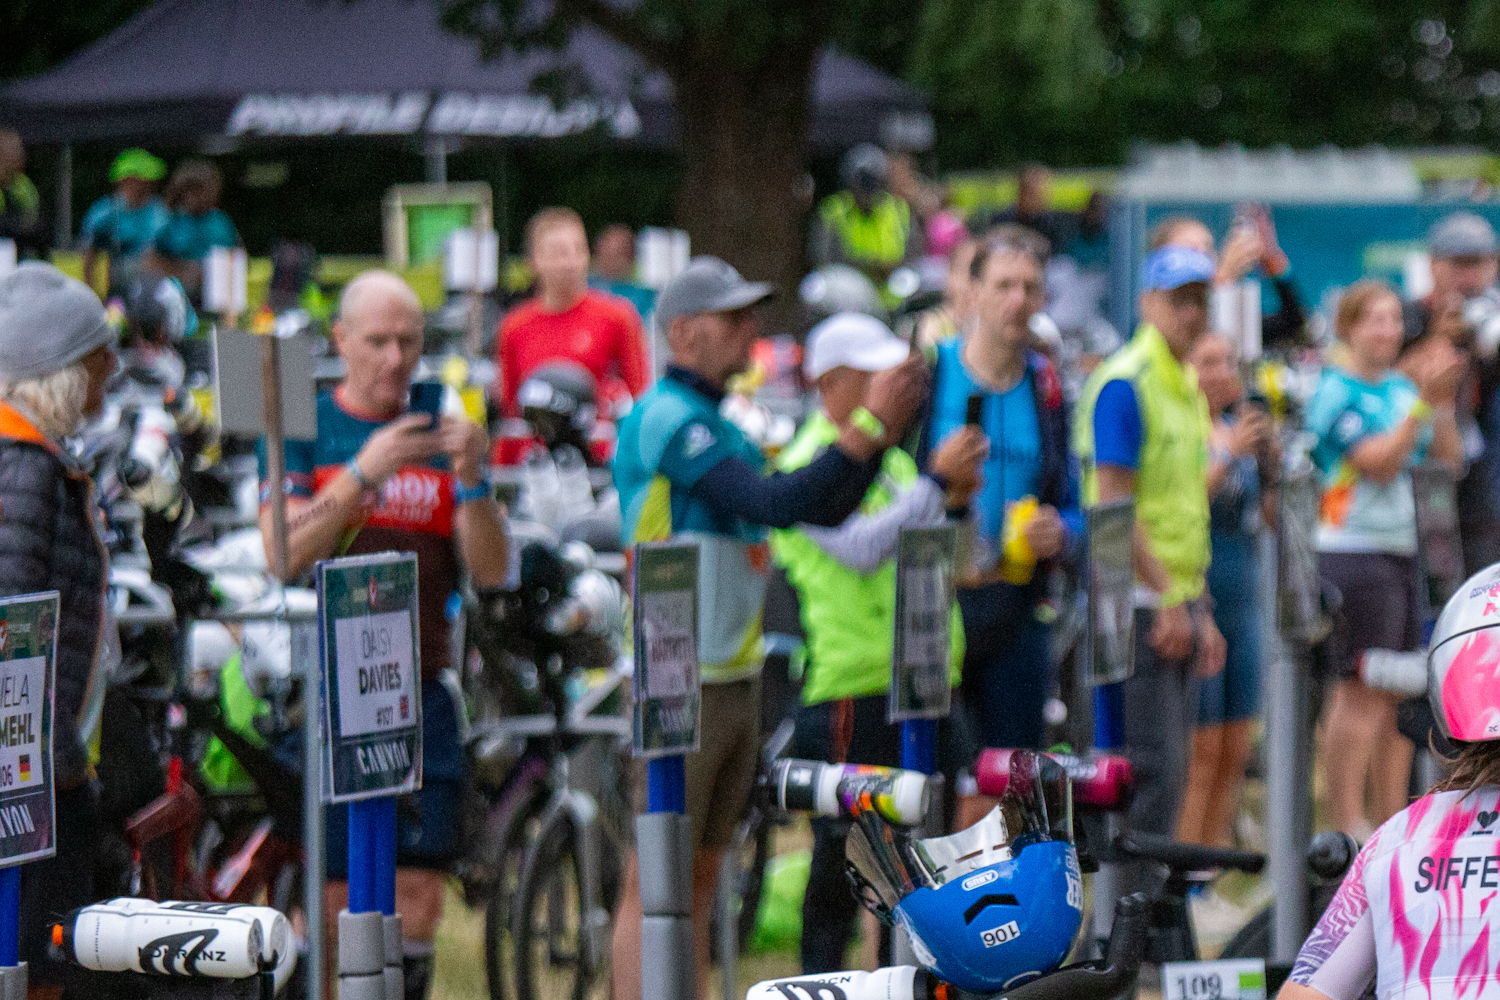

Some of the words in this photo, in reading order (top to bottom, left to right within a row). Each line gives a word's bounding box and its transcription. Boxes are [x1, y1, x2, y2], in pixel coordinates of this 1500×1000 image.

[359, 662, 402, 695] DAVIES
[964, 872, 997, 888] ABUS
[983, 923, 1020, 947] 106
[1178, 973, 1222, 1000] 109
